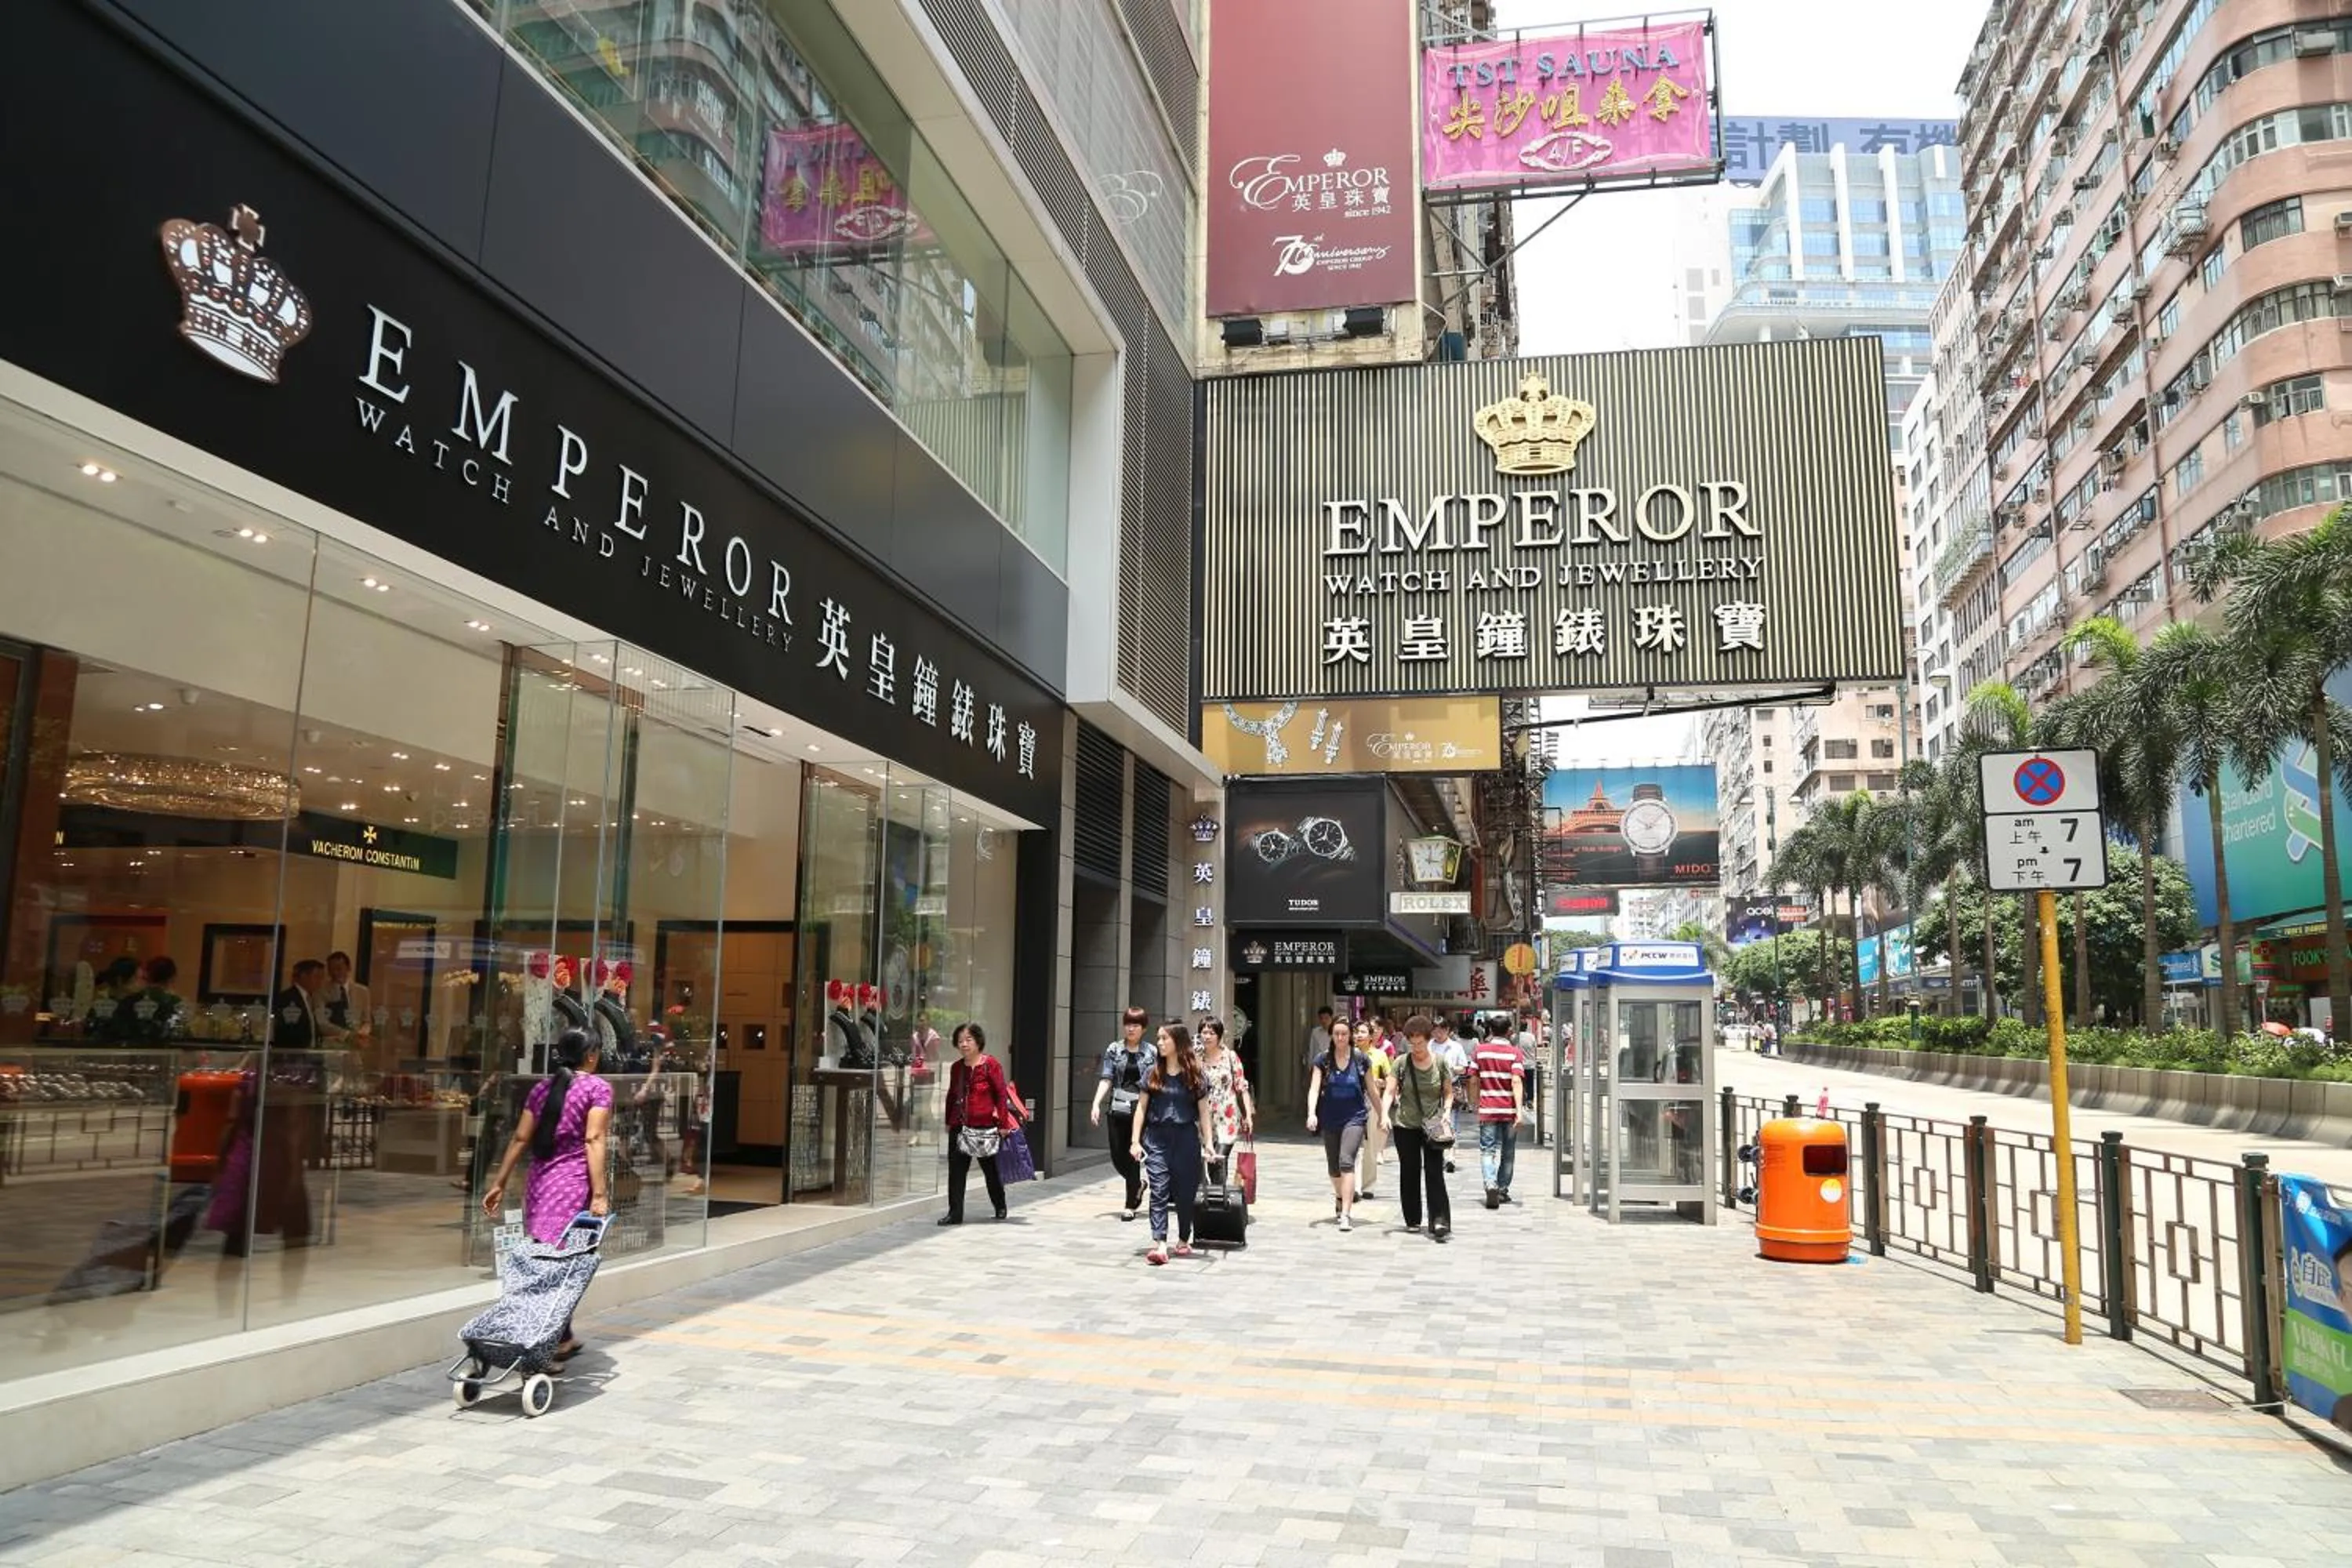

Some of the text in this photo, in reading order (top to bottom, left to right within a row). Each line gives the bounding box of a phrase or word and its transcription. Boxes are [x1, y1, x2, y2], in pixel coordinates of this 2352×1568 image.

[1447, 44, 1679, 88] TST SAUNA
[1443, 74, 1689, 140] 尖沙咀桑拿
[1292, 187, 1389, 212] 英皇珠寶
[1372, 205, 1391, 214] 1942
[359, 303, 793, 626] EMPEROR
[354, 397, 793, 652] WATCH AND JEWELLERY
[1323, 481, 1762, 556] EMPEROR
[1324, 557, 1764, 595] WATCH AND JEWELLERY
[1323, 601, 1766, 665] 英皇鐘錶珠寶
[816, 597, 1036, 780] 英皇鐘錶珠寶
[2014, 818, 2034, 827] am
[2060, 818, 2078, 842] 7
[2009, 831, 2042, 844] 上午
[312, 840, 420, 871] VACHERON CONSTANTIN
[2018, 858, 2038, 869] pm
[1675, 863, 1711, 874] MIDO
[2012, 870, 2045, 884] 下午
[2063, 858, 2082, 882] 7
[1403, 896, 1466, 909] ROLEX
[1274, 942, 1334, 951] EMPEROR
